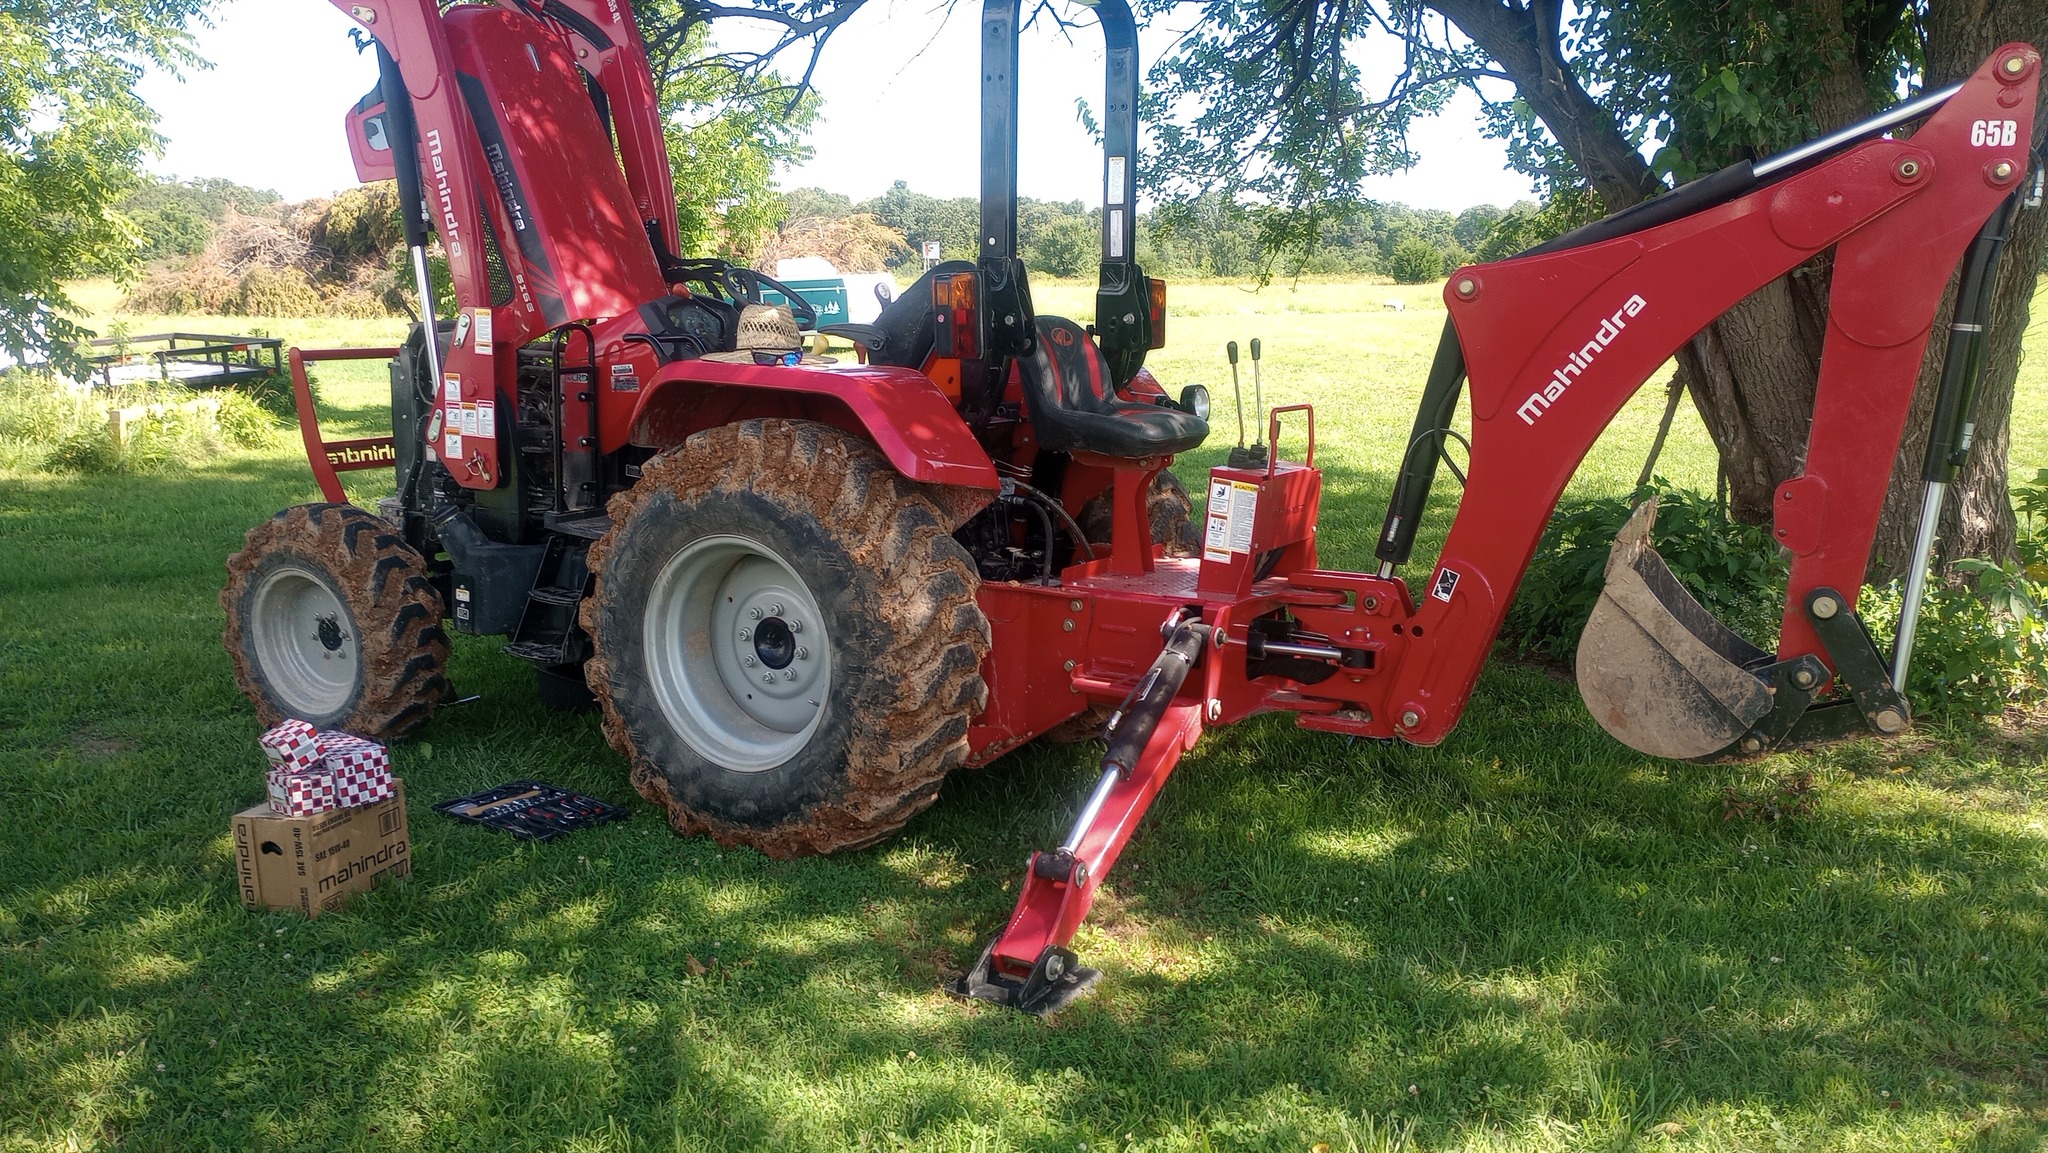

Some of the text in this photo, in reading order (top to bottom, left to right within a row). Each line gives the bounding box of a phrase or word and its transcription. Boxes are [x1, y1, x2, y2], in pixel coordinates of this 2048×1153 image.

[1970, 119, 2018, 147] 65B
[293, 827, 304, 858] 15W-40
[315, 839, 350, 862] SAE 15W-40
[298, 861, 306, 876] SAE
[318, 840, 406, 894] mahindra
